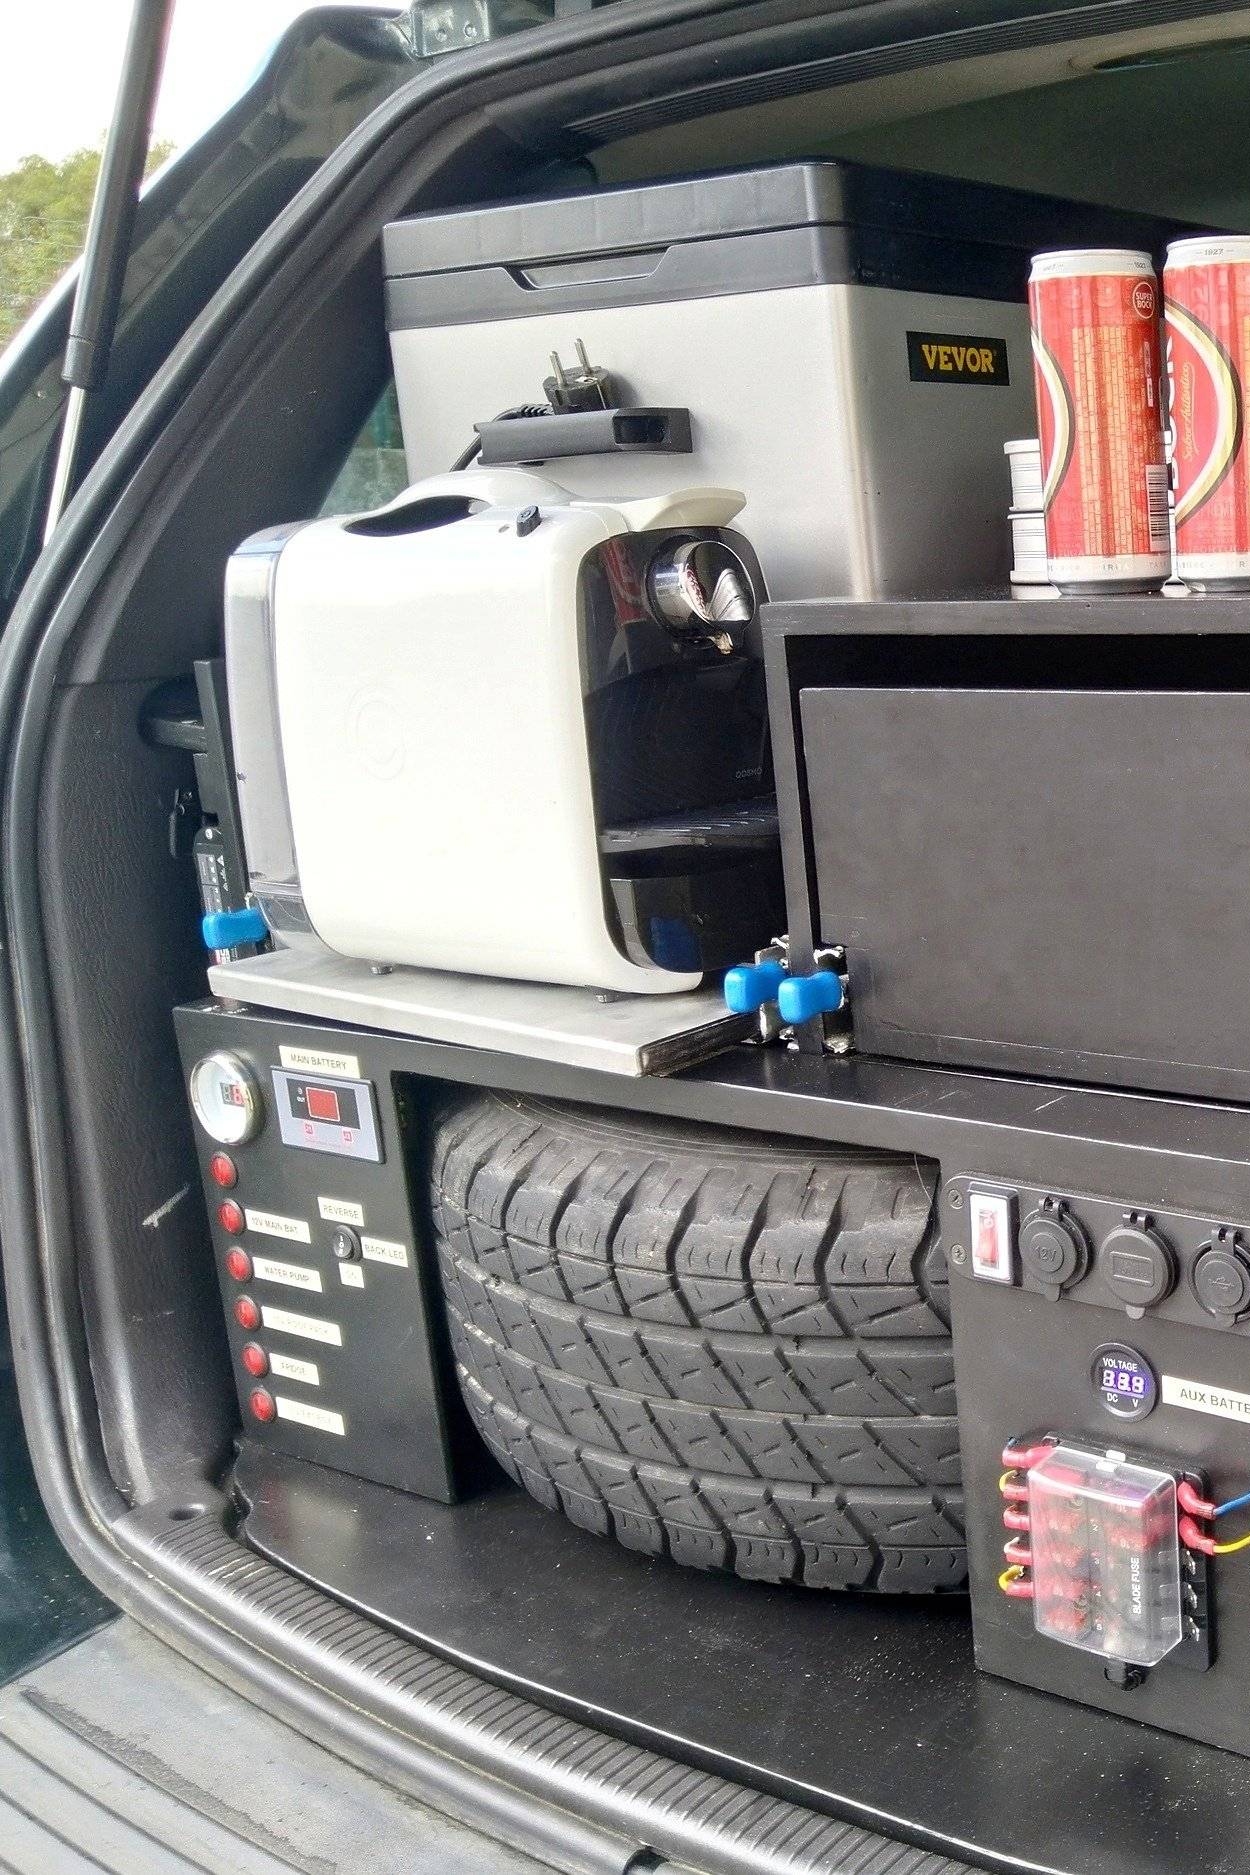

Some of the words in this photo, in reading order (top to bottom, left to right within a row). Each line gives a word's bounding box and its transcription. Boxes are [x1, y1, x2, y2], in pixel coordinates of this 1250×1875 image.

[921, 344, 995, 374] VEVOR
[290, 1052, 311, 1067] MAIN
[310, 1055, 348, 1071] BATTERY
[322, 1204, 360, 1220] REVERSE
[263, 1264, 289, 1279] WATER
[288, 1269, 311, 1284] PUMP
[1102, 1356, 1138, 1373] VOLTAGE
[1106, 1392, 1119, 1404] DC
[1132, 1398, 1139, 1408] V
[1179, 1387, 1207, 1404] AUX
[1130, 1556, 1140, 1583] FUSE
[1131, 1583, 1142, 1615] BLADE
